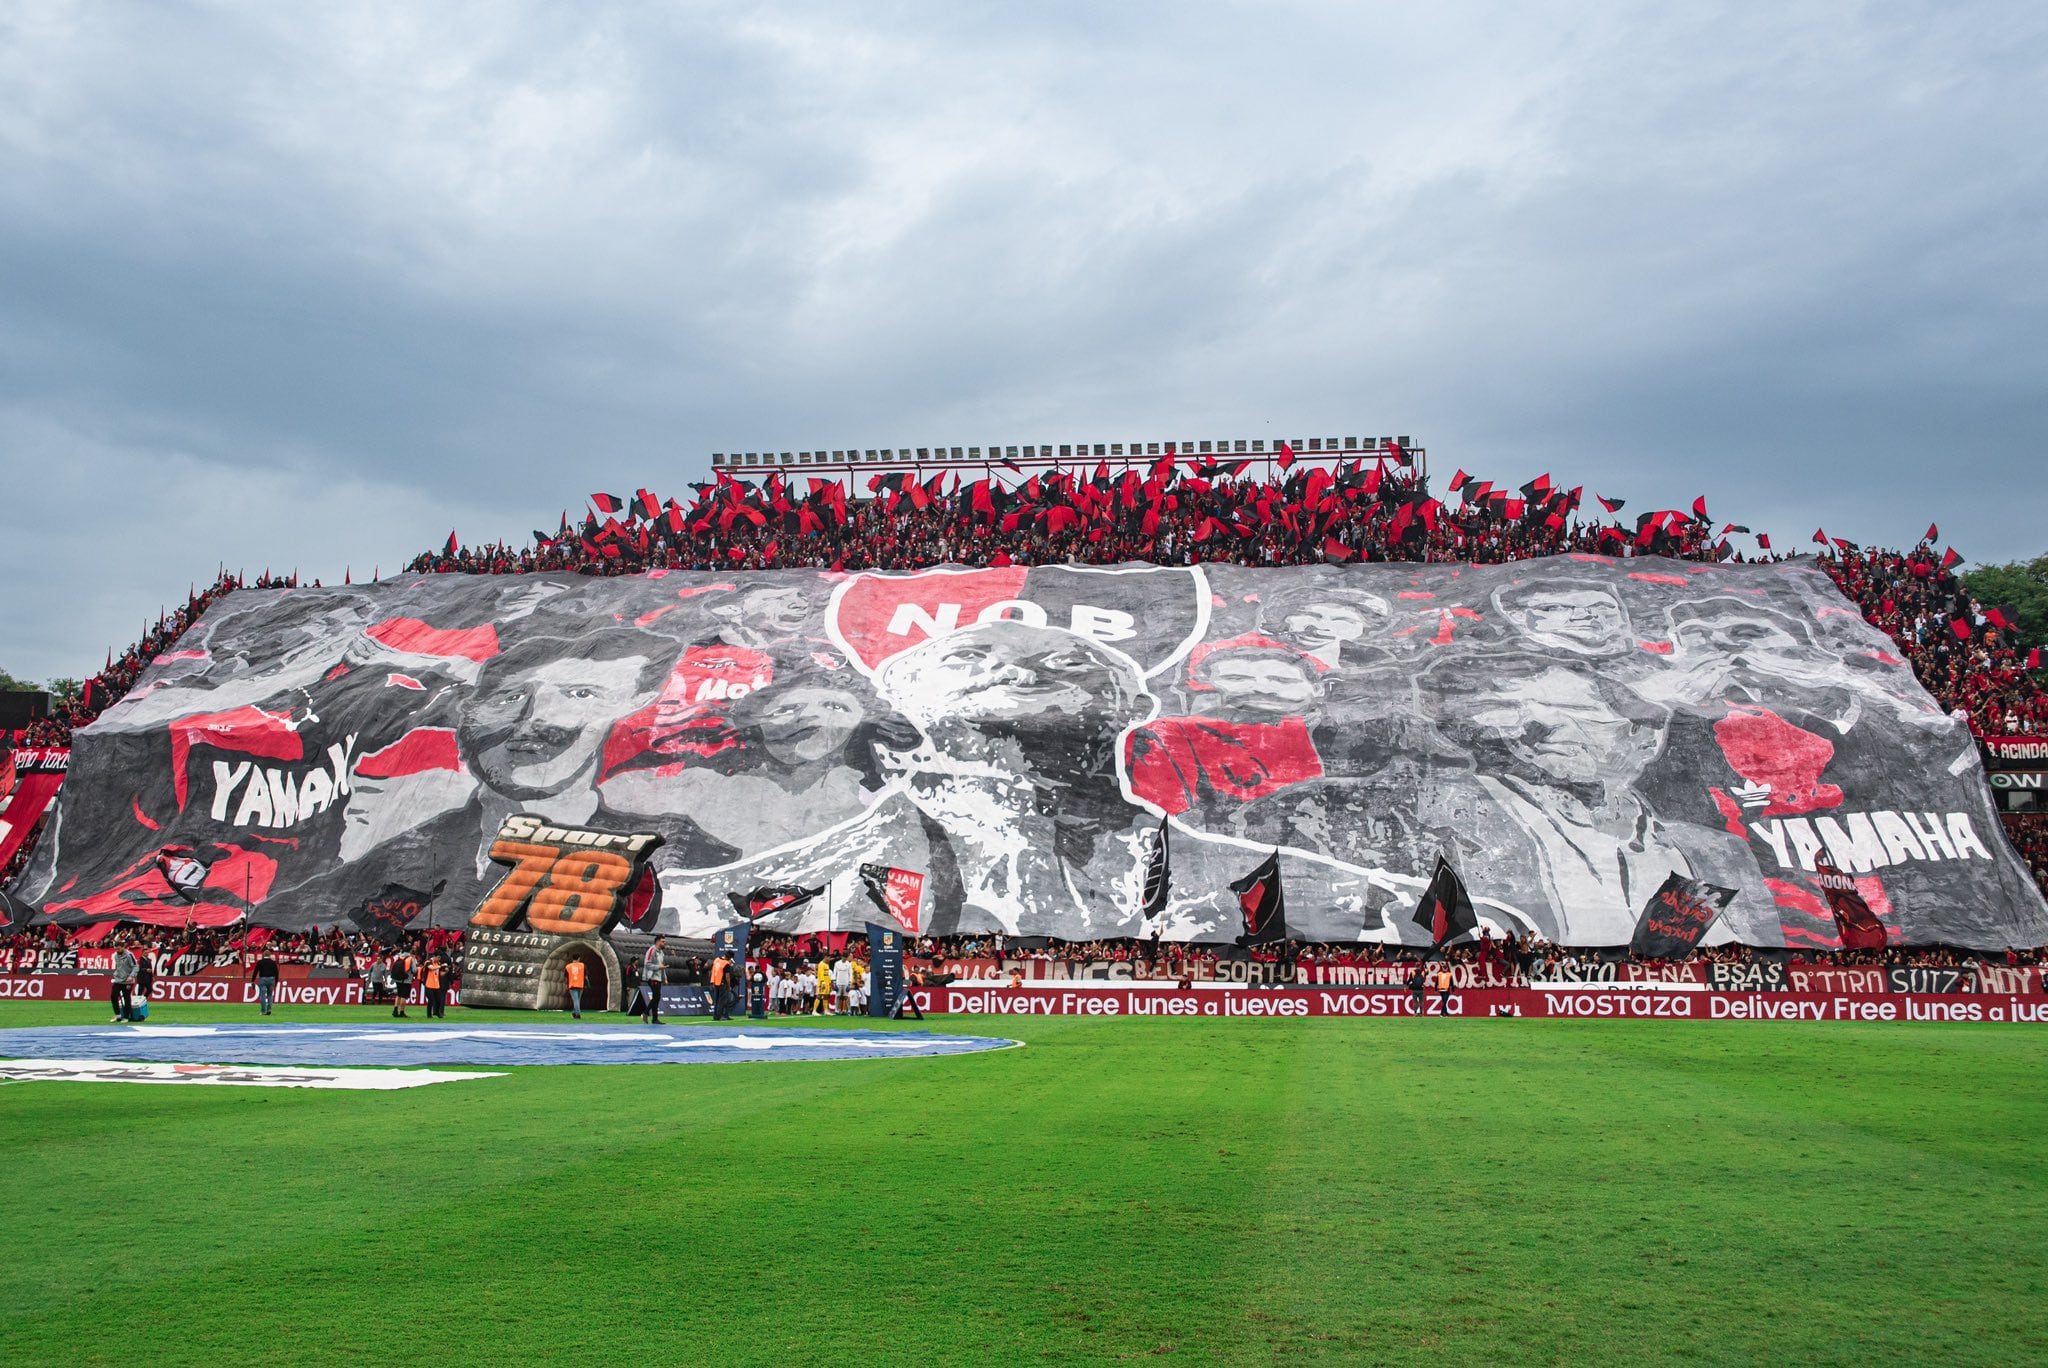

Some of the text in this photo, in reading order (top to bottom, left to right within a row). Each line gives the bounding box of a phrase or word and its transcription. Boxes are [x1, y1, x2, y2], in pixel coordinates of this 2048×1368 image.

[500, 816, 656, 850] Sport
[1749, 811, 1993, 873] YAMAHA
[470, 840, 632, 933] 78
[470, 946, 498, 956] por
[471, 930, 549, 946] Rosarino
[467, 961, 534, 975] deporte
[243, 981, 340, 1005] Dlivery
[948, 990, 1056, 1015] Delivery
[1062, 993, 1120, 1015] Free
[1128, 992, 1199, 1015] lunes
[1204, 1001, 1217, 1015] a
[1224, 992, 1309, 1017] jueves
[1710, 994, 1827, 1020] Delivery
[1834, 997, 1897, 1020] Free
[1905, 997, 1982, 1020] lunes
[1989, 1006, 2004, 1021] a
